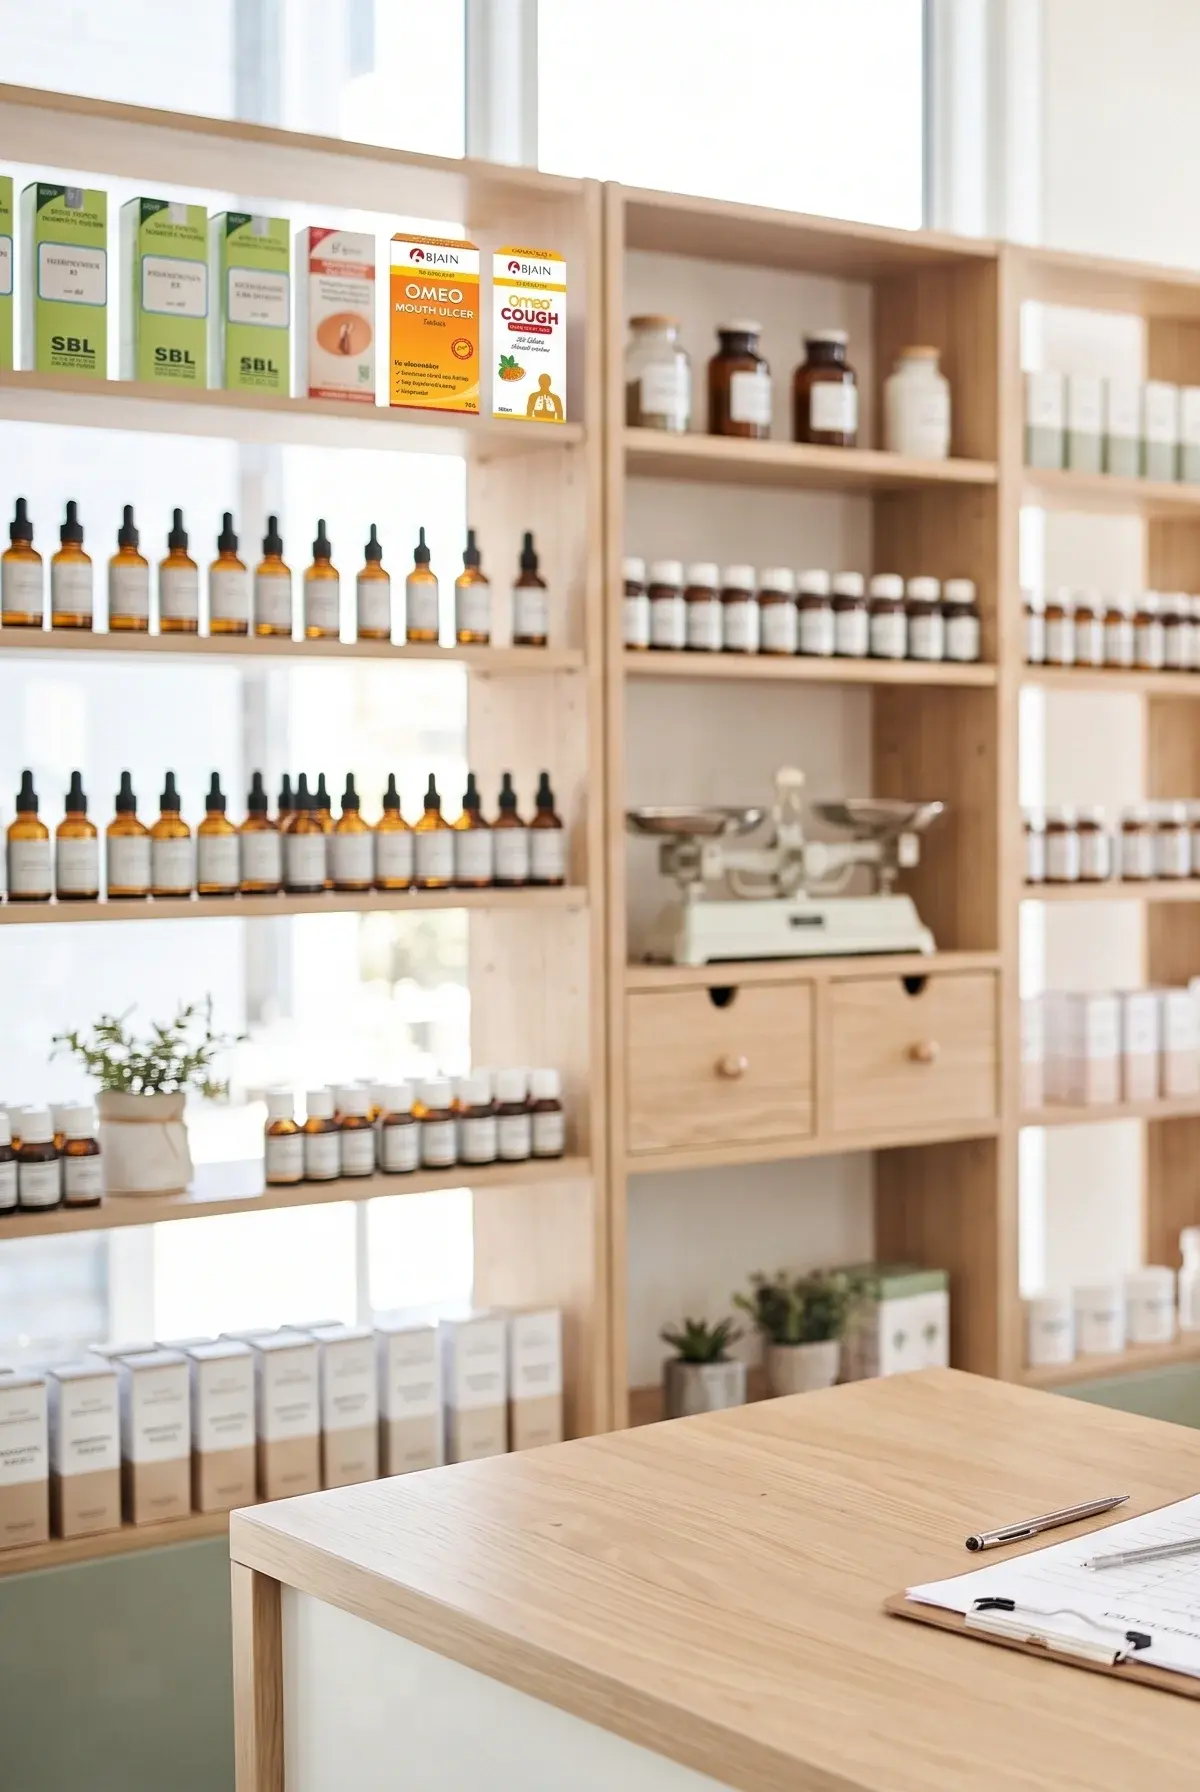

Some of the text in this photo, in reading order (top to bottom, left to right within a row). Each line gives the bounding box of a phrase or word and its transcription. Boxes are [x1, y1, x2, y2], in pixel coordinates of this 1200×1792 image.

[426, 252, 459, 265] BJAIN
[521, 264, 552, 276] BJAIN
[405, 283, 463, 304] OMEO
[395, 303, 474, 319] MOUTH ULCER
[501, 307, 559, 325] COUGH
[51, 335, 96, 354] SBL
[154, 346, 196, 365] SBL
[239, 356, 279, 373] SBL
